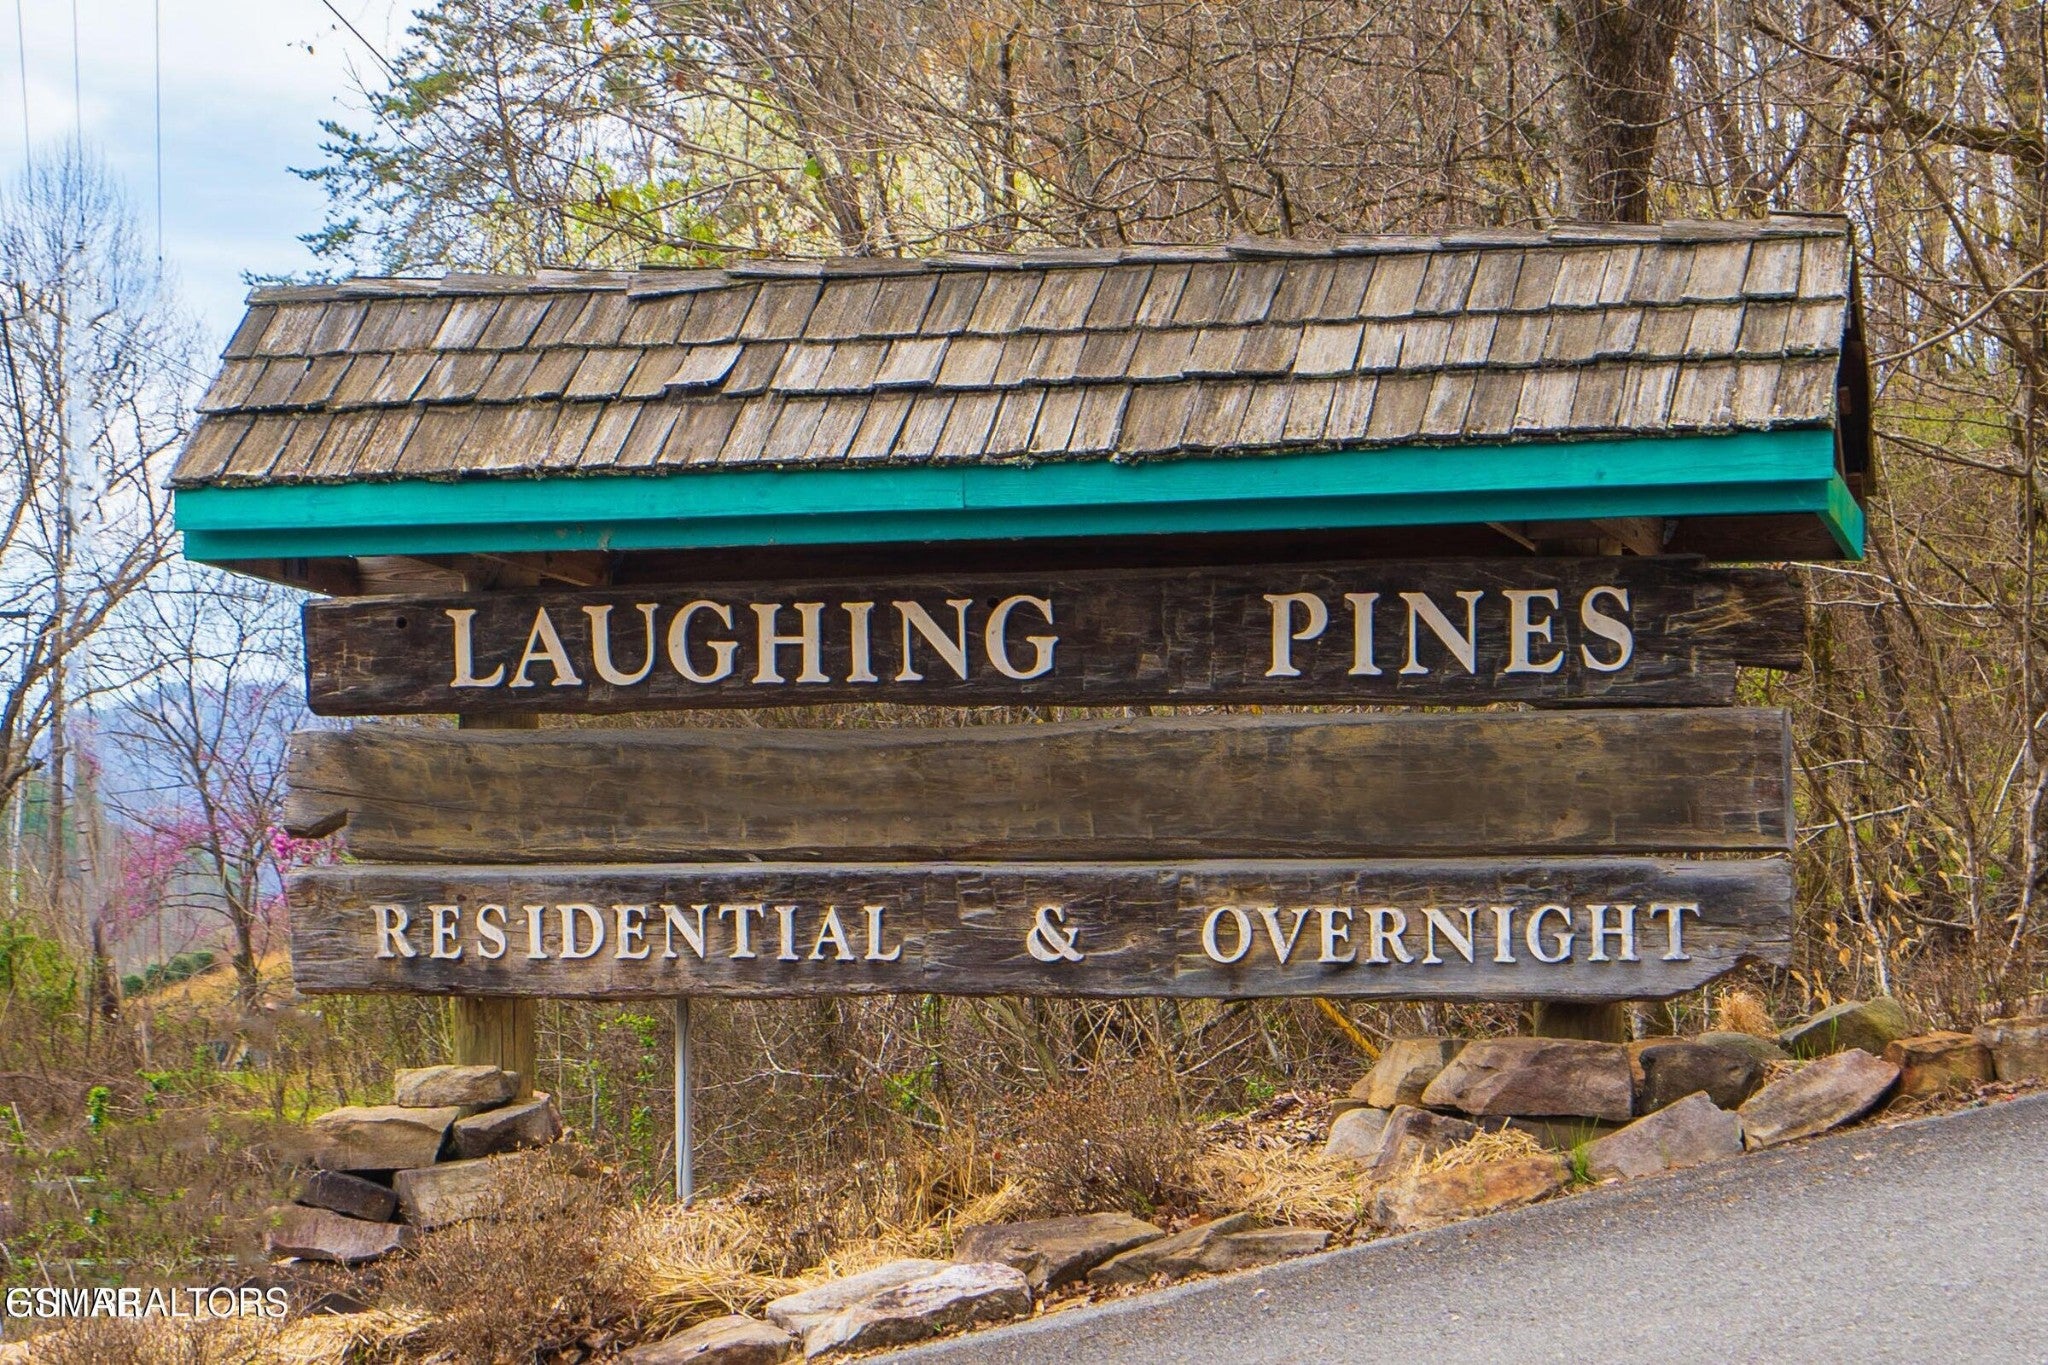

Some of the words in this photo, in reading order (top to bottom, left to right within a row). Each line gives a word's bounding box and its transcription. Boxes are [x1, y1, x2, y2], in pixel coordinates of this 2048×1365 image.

[445, 594, 1060, 689] LAUGHING
[1262, 585, 1635, 678] PINES
[371, 903, 901, 963] RESIDENTIAL
[1025, 904, 1085, 964] &
[1200, 902, 1700, 966] OVERNIGHT
